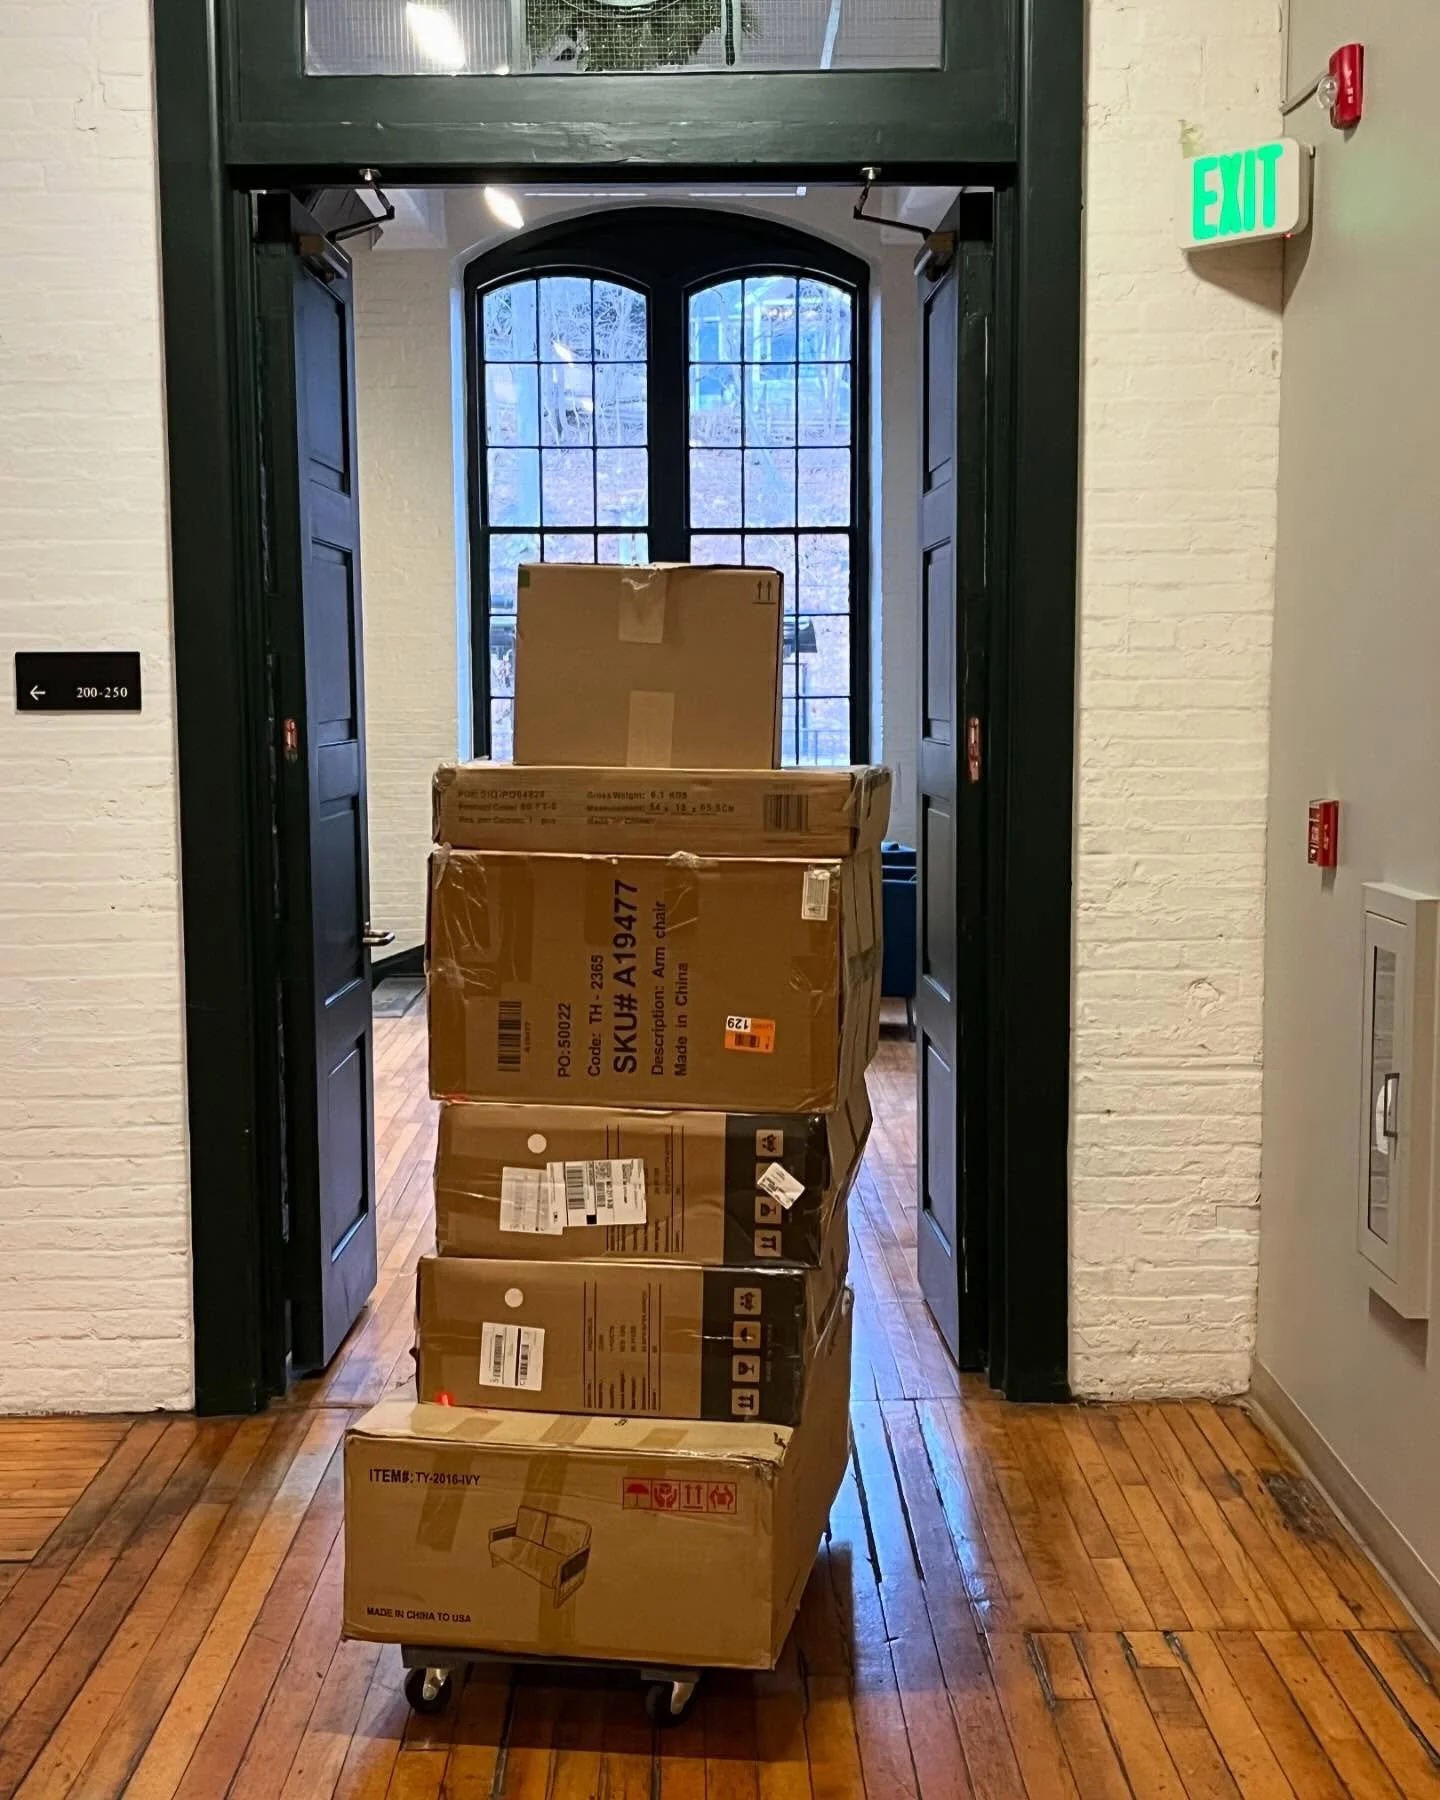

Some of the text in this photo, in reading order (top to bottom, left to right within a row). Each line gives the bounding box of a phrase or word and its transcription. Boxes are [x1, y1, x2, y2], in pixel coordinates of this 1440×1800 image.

[1193, 143, 1283, 240] EXIT
[76, 687, 128, 698] 200-250
[591, 954, 603, 989] 2365
[613, 880, 638, 1074] SKU# A19477
[652, 902, 666, 1076] Description: Arm chair
[589, 1005, 602, 1024] TH
[674, 963, 688, 1076] Made in China
[727, 1017, 749, 1030] 129
[558, 1003, 571, 1077] PO:50022
[588, 1033, 601, 1076] Code:
[369, 1468, 413, 1483] ITEM#:
[366, 1607, 472, 1623] MADE IN CHINA TO USA
